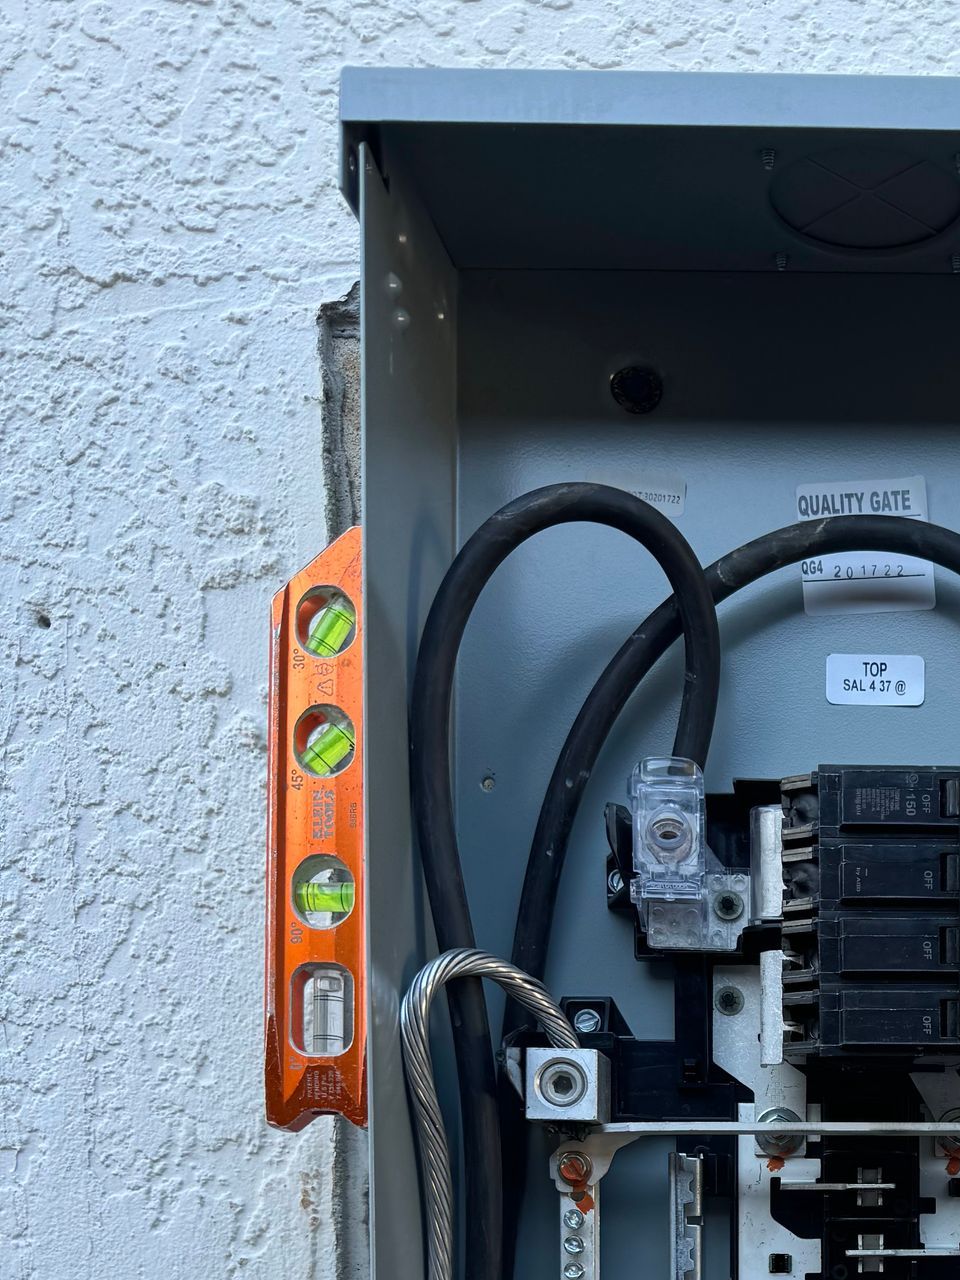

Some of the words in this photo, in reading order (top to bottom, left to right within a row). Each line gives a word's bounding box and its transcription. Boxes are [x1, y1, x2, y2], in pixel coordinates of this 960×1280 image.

[798, 492, 865, 517] QUALITY
[870, 490, 911, 512] GATE
[801, 559, 824, 576] QG4
[294, 647, 305, 670] 30°
[862, 662, 887, 677] TOP
[843, 679, 866, 692] SAL
[869, 680, 876, 692] 4
[879, 680, 892, 692] 37
[895, 680, 906, 696] @
[291, 769, 304, 790] 45°
[324, 789, 335, 839] TOOLS
[905, 793, 917, 816] 150
[922, 794, 931, 814] OFF
[312, 790, 323, 840] KLEIN
[923, 870, 933, 890] OFF
[290, 921, 303, 944] 90°
[923, 941, 932, 960] OFF
[922, 1015, 932, 1035] OFF
